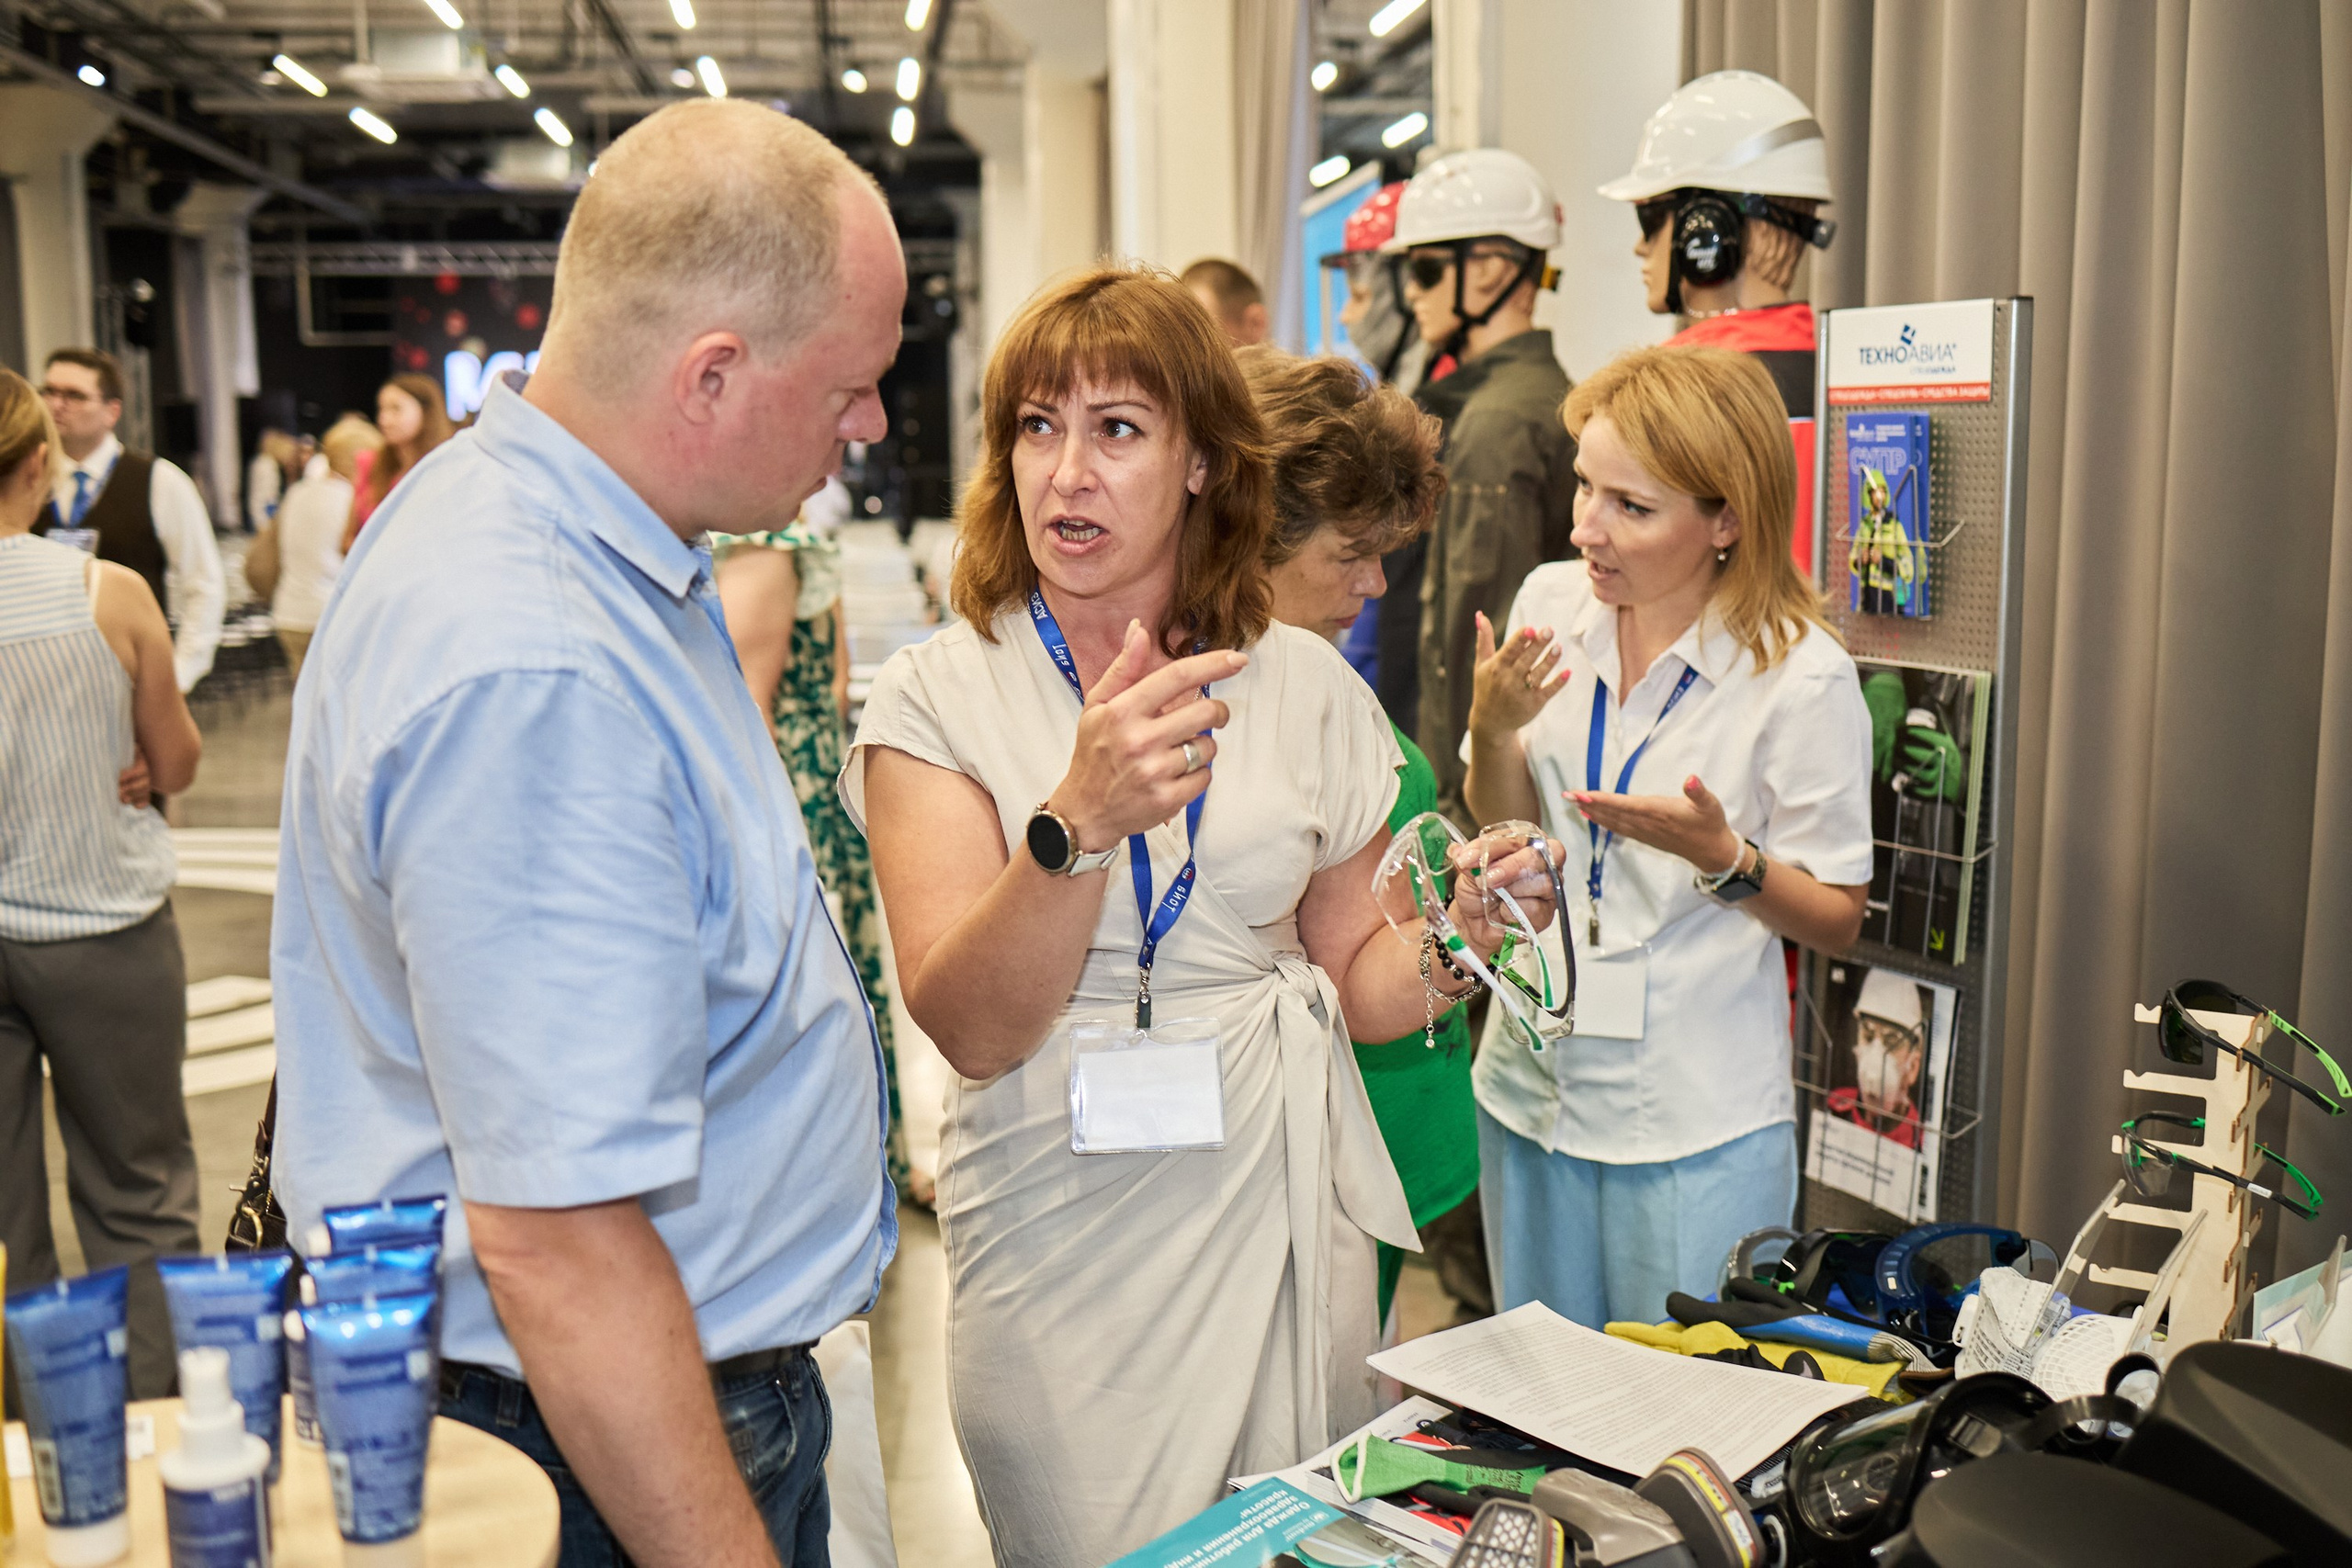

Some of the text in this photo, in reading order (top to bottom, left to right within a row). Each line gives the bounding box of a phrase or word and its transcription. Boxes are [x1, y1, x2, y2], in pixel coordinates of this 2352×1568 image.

[1203, 1495, 1298, 1552] здравоохранения
[1263, 1501, 1310, 1529] Одежда
[1241, 1524, 1265, 1542] для
[1193, 1549, 1204, 1559] и
